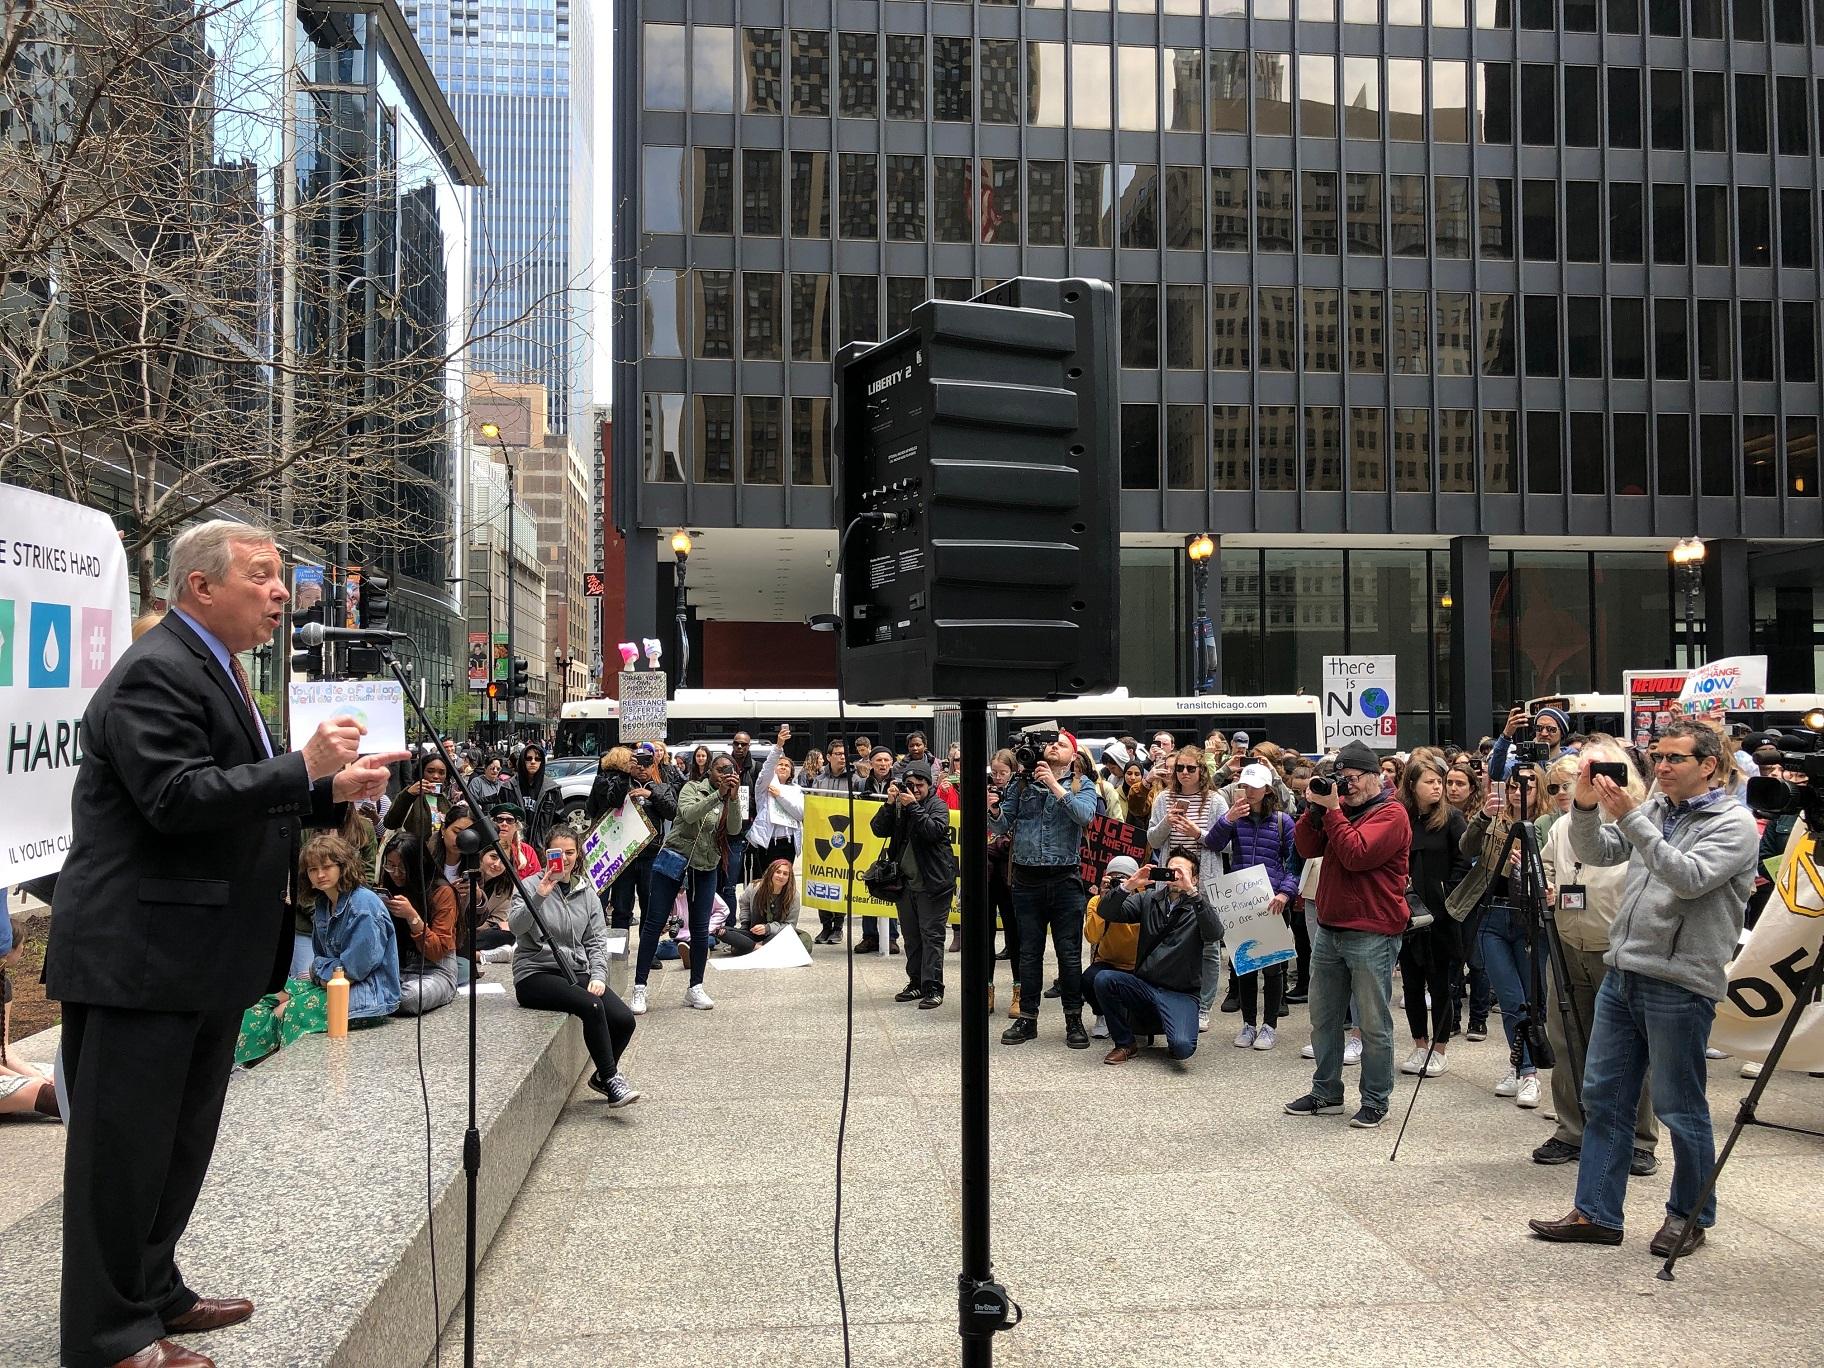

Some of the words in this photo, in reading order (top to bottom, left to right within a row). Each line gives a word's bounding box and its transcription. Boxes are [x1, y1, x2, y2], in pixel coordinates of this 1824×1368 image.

[868, 369, 903, 396] LIBERTY
[905, 365, 912, 379] 2
[13, 541, 67, 573] STRIKES
[69, 551, 100, 577] HARD
[1328, 657, 1375, 675] there
[1346, 678, 1356, 689] is
[1694, 677, 1734, 693] NOW
[1176, 700, 1267, 711] transitchicago.com
[1731, 696, 1765, 710] LATER
[622, 721, 667, 730] REVOLUTION
[1324, 718, 1380, 745] planet
[1384, 718, 1392, 733] B
[8, 847, 19, 864] IL
[19, 838, 55, 862] YOUTH
[1102, 836, 1145, 859] WHETHER
[595, 854, 625, 889] DESTROY
[844, 894, 869, 904] Nclear
[1207, 882, 1232, 901] The
[1239, 914, 1254, 925] are
[1257, 910, 1269, 918] we
